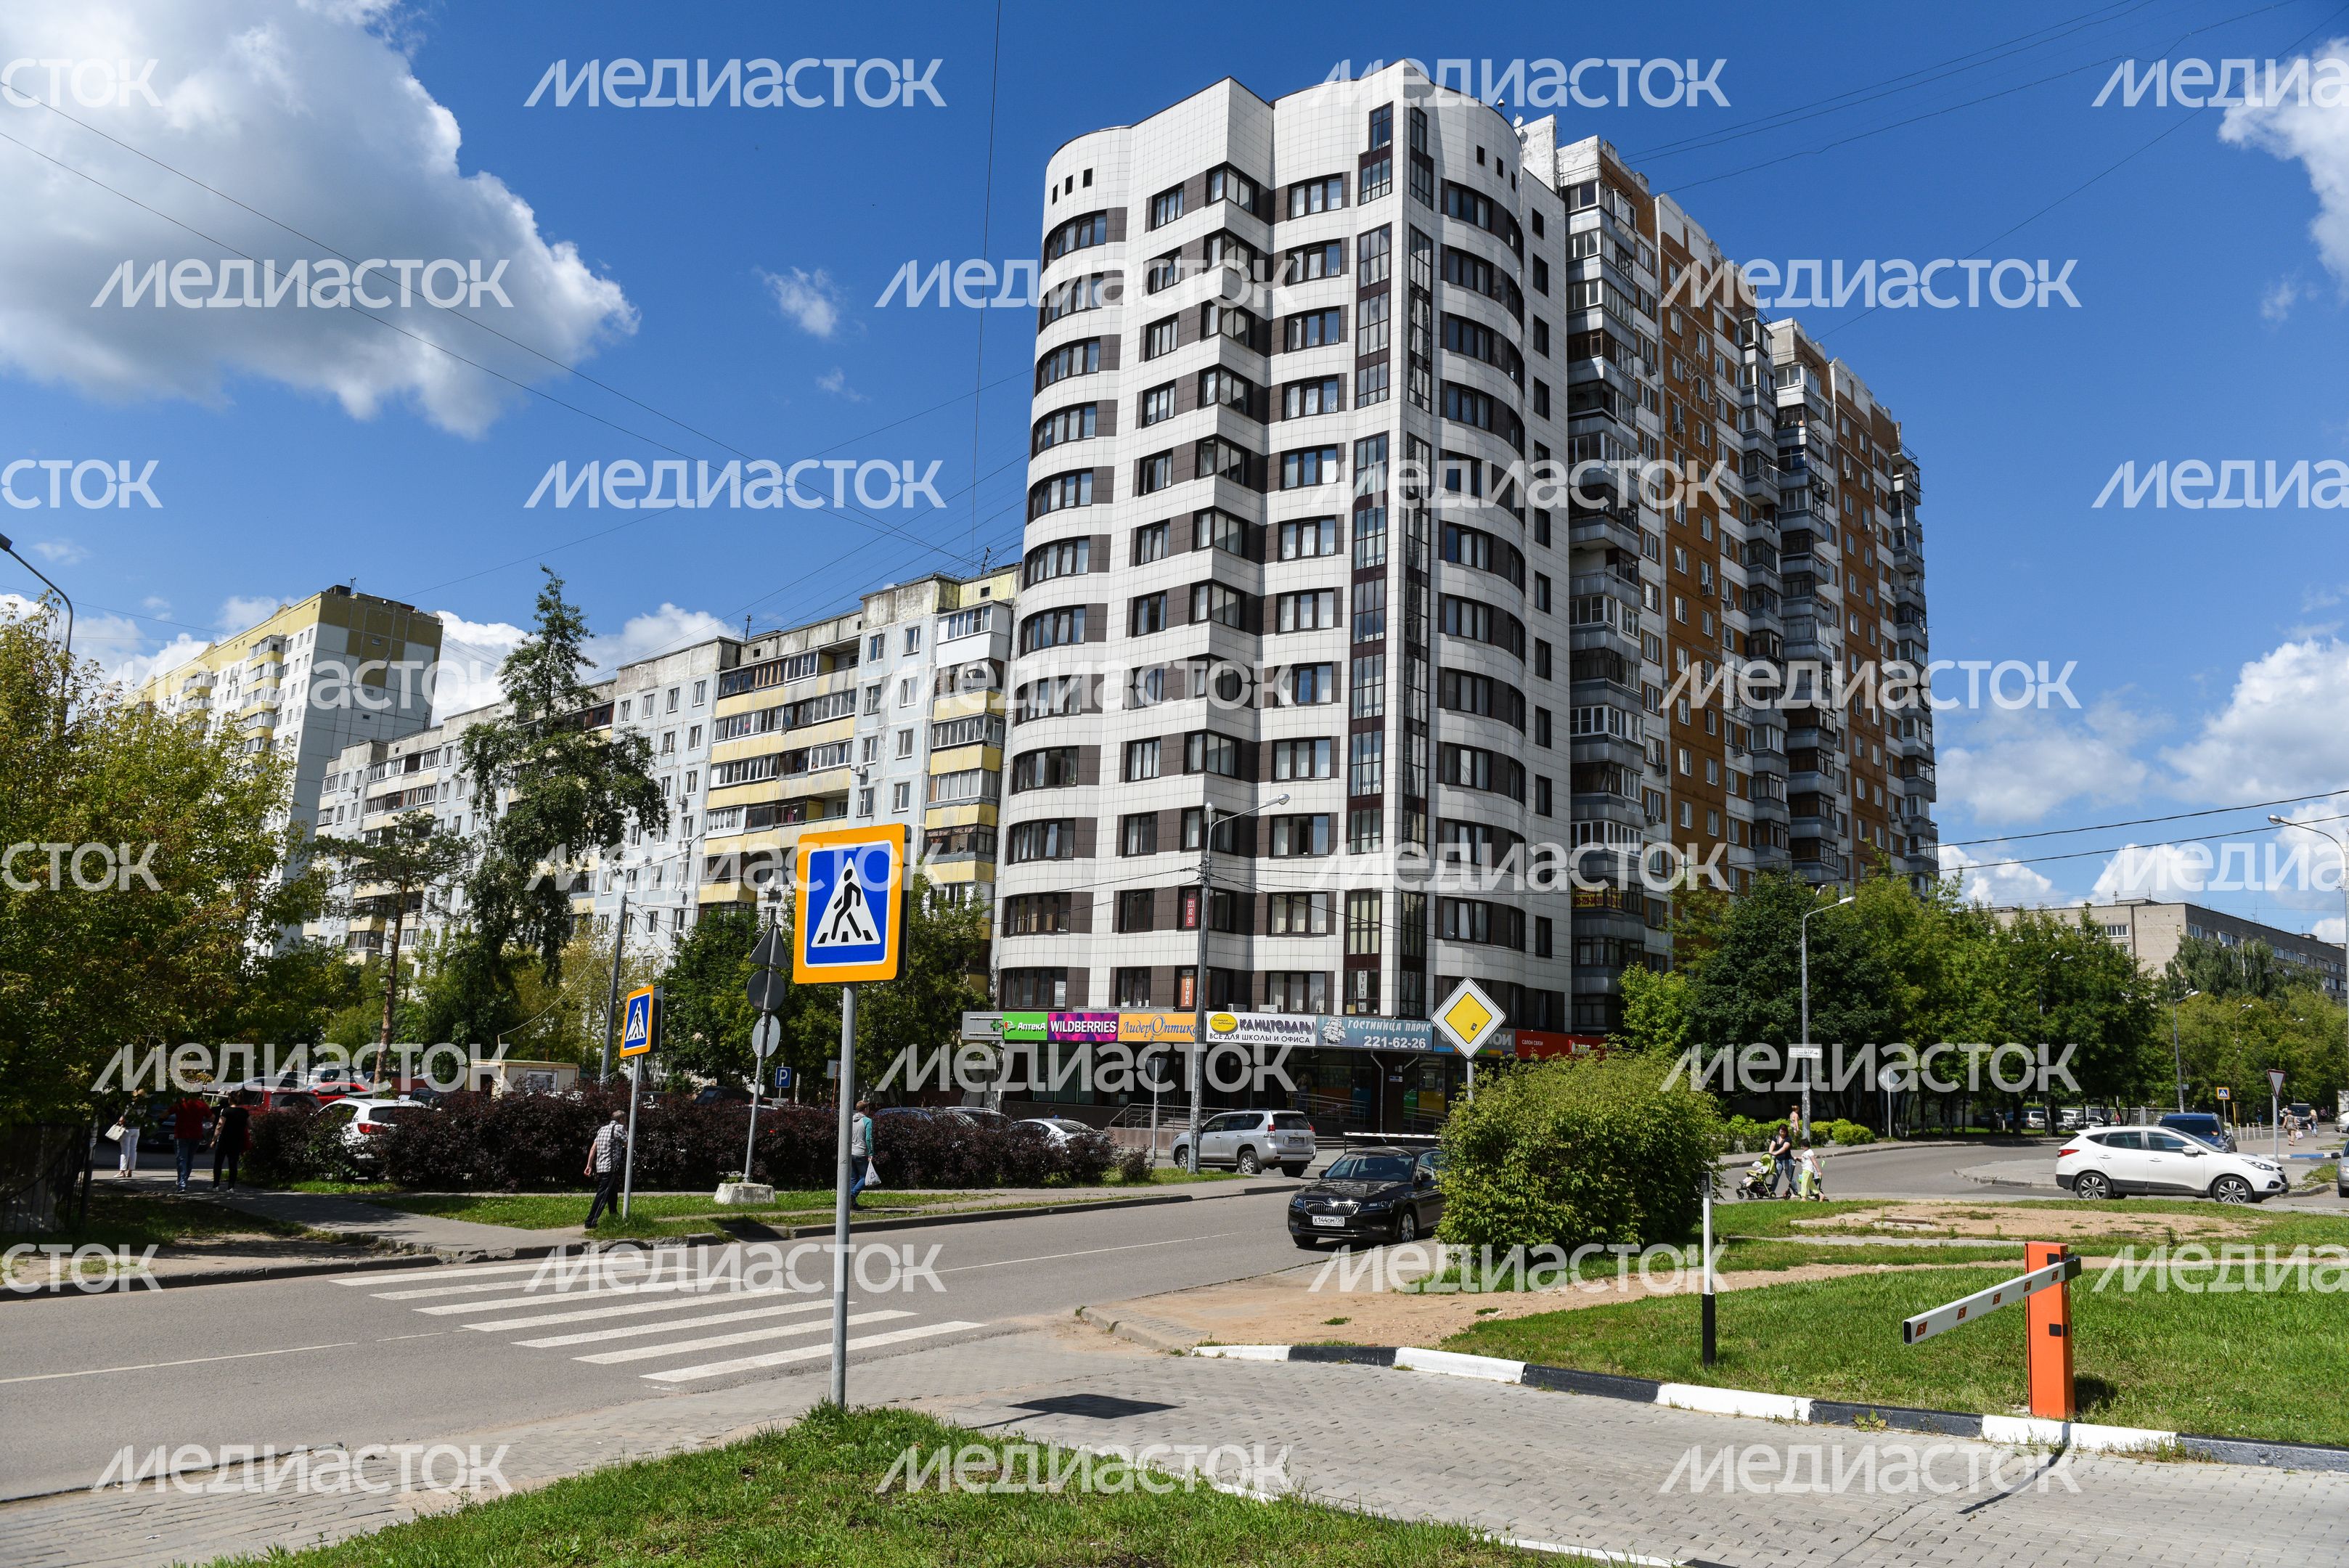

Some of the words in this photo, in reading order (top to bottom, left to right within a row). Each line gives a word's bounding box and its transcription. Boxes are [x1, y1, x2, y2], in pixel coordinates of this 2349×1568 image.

[1050, 1021, 1116, 1033] WILDBERRIES
[1239, 1018, 1315, 1034] КАНЦТОВАРЫ
[1347, 1019, 1401, 1032] ГОСТИНИЦА
[1405, 1022, 1431, 1032] ПАРУС
[1364, 1035, 1426, 1048] 221-62-26
